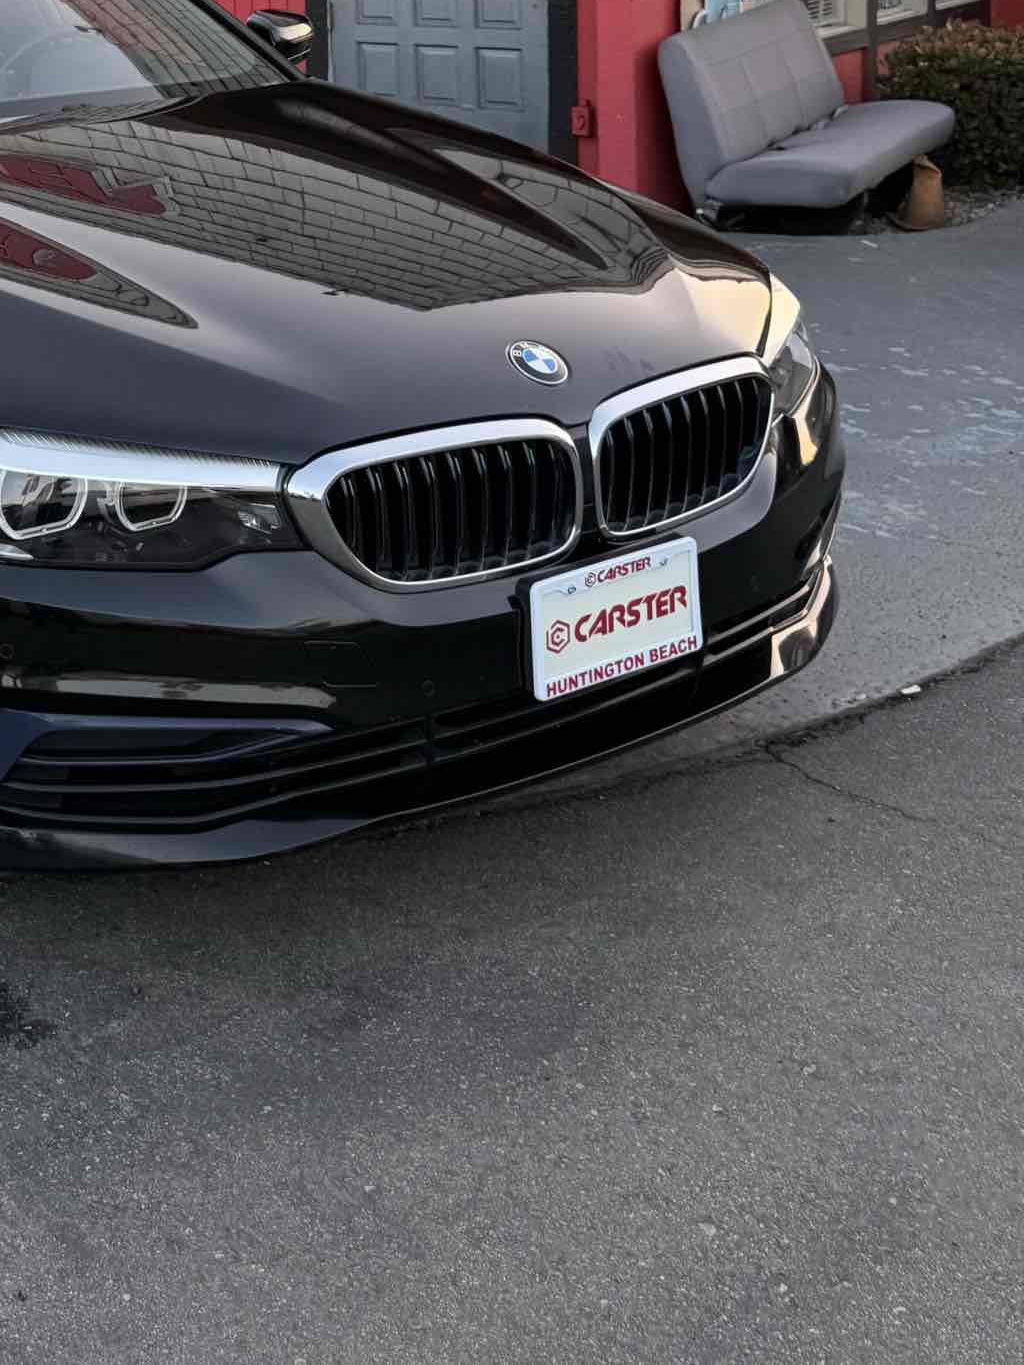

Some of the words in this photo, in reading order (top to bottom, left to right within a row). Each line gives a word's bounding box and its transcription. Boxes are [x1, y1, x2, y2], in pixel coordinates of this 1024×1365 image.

[596, 556, 651, 585] CARSTER
[575, 585, 688, 643] CARSTER
[546, 651, 645, 698] HUNTINGTON
[649, 635, 698, 664] BEACH
